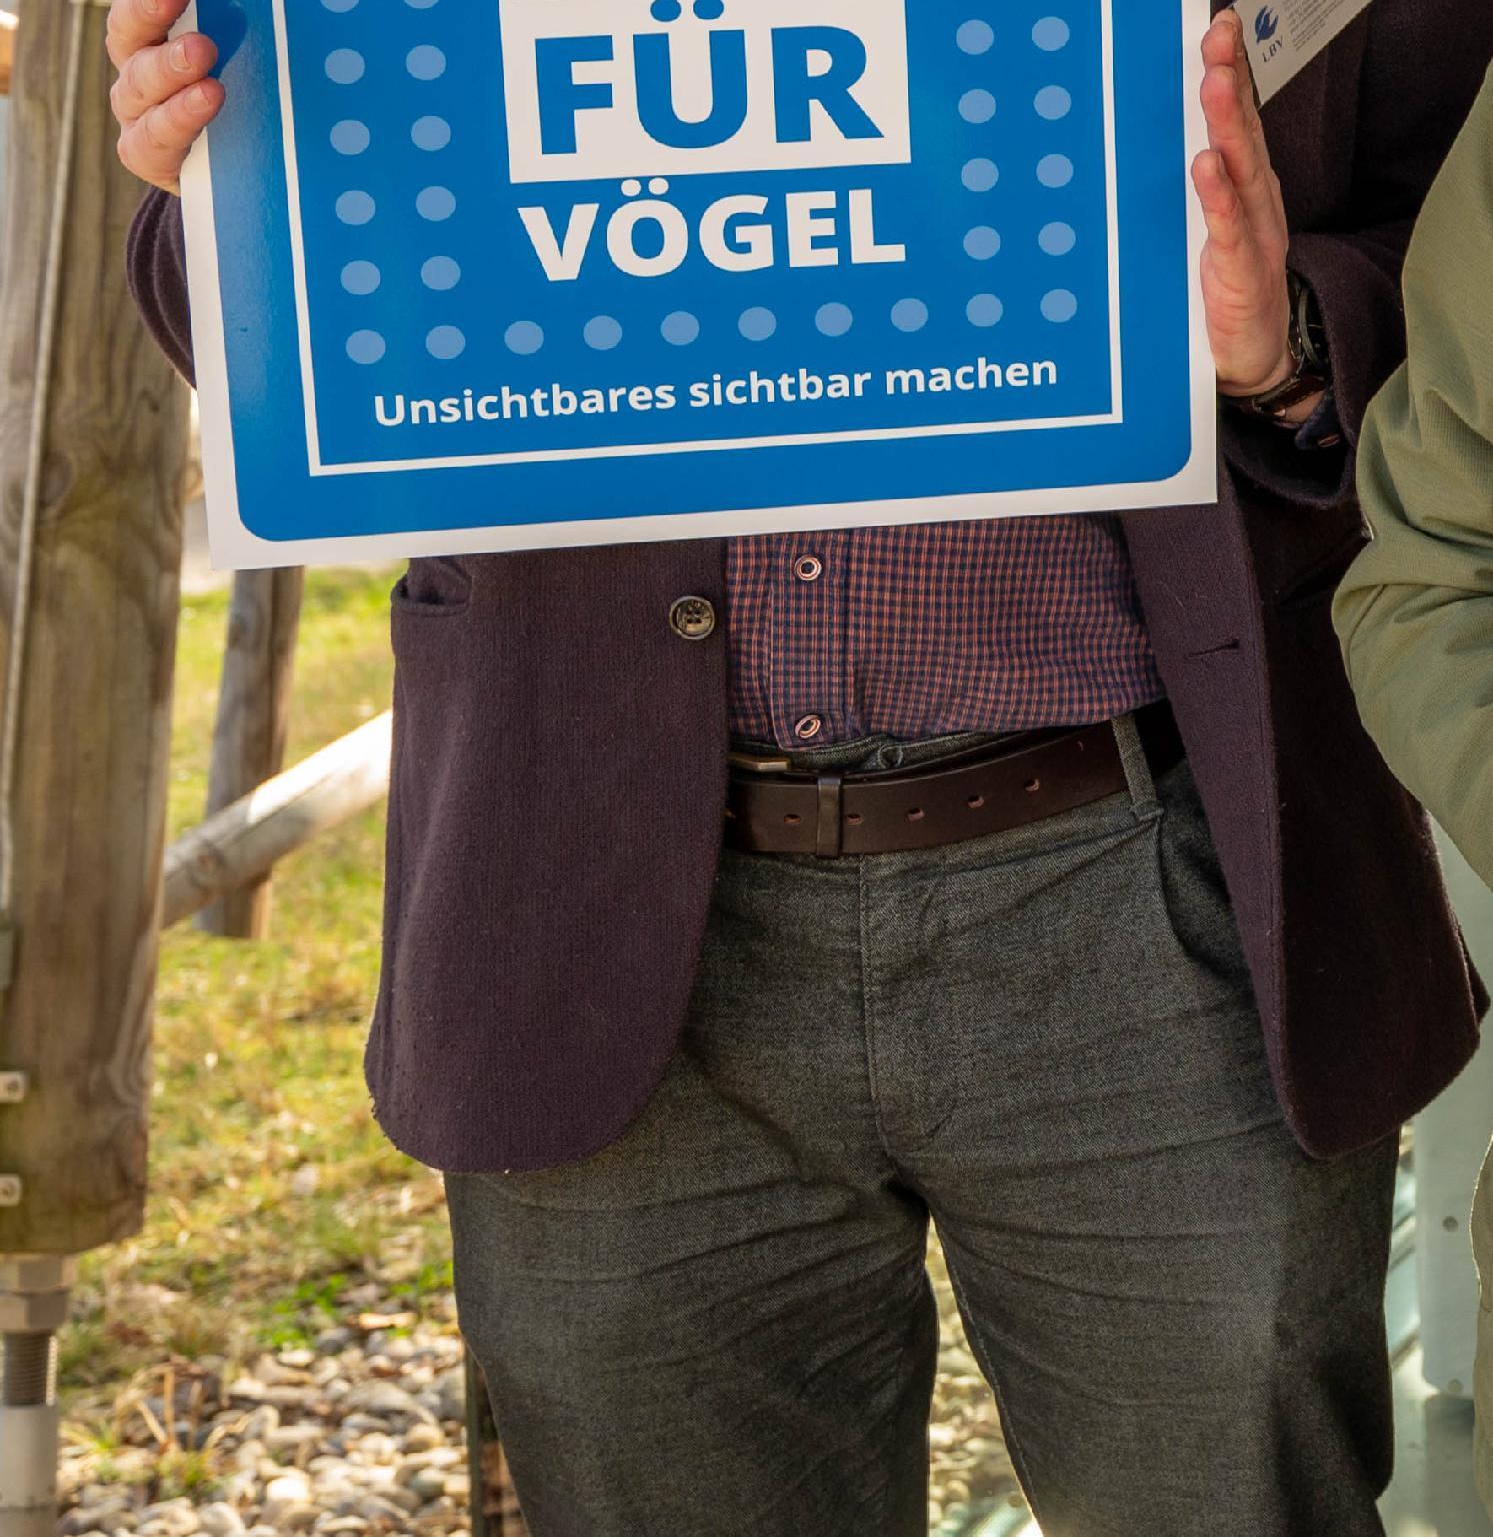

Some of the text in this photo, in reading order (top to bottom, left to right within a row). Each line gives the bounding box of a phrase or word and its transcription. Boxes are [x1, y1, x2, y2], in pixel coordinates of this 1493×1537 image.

[517, 178, 906, 282] VÖGEL
[374, 356, 1057, 428] Unsichtbares sichtbar machen
